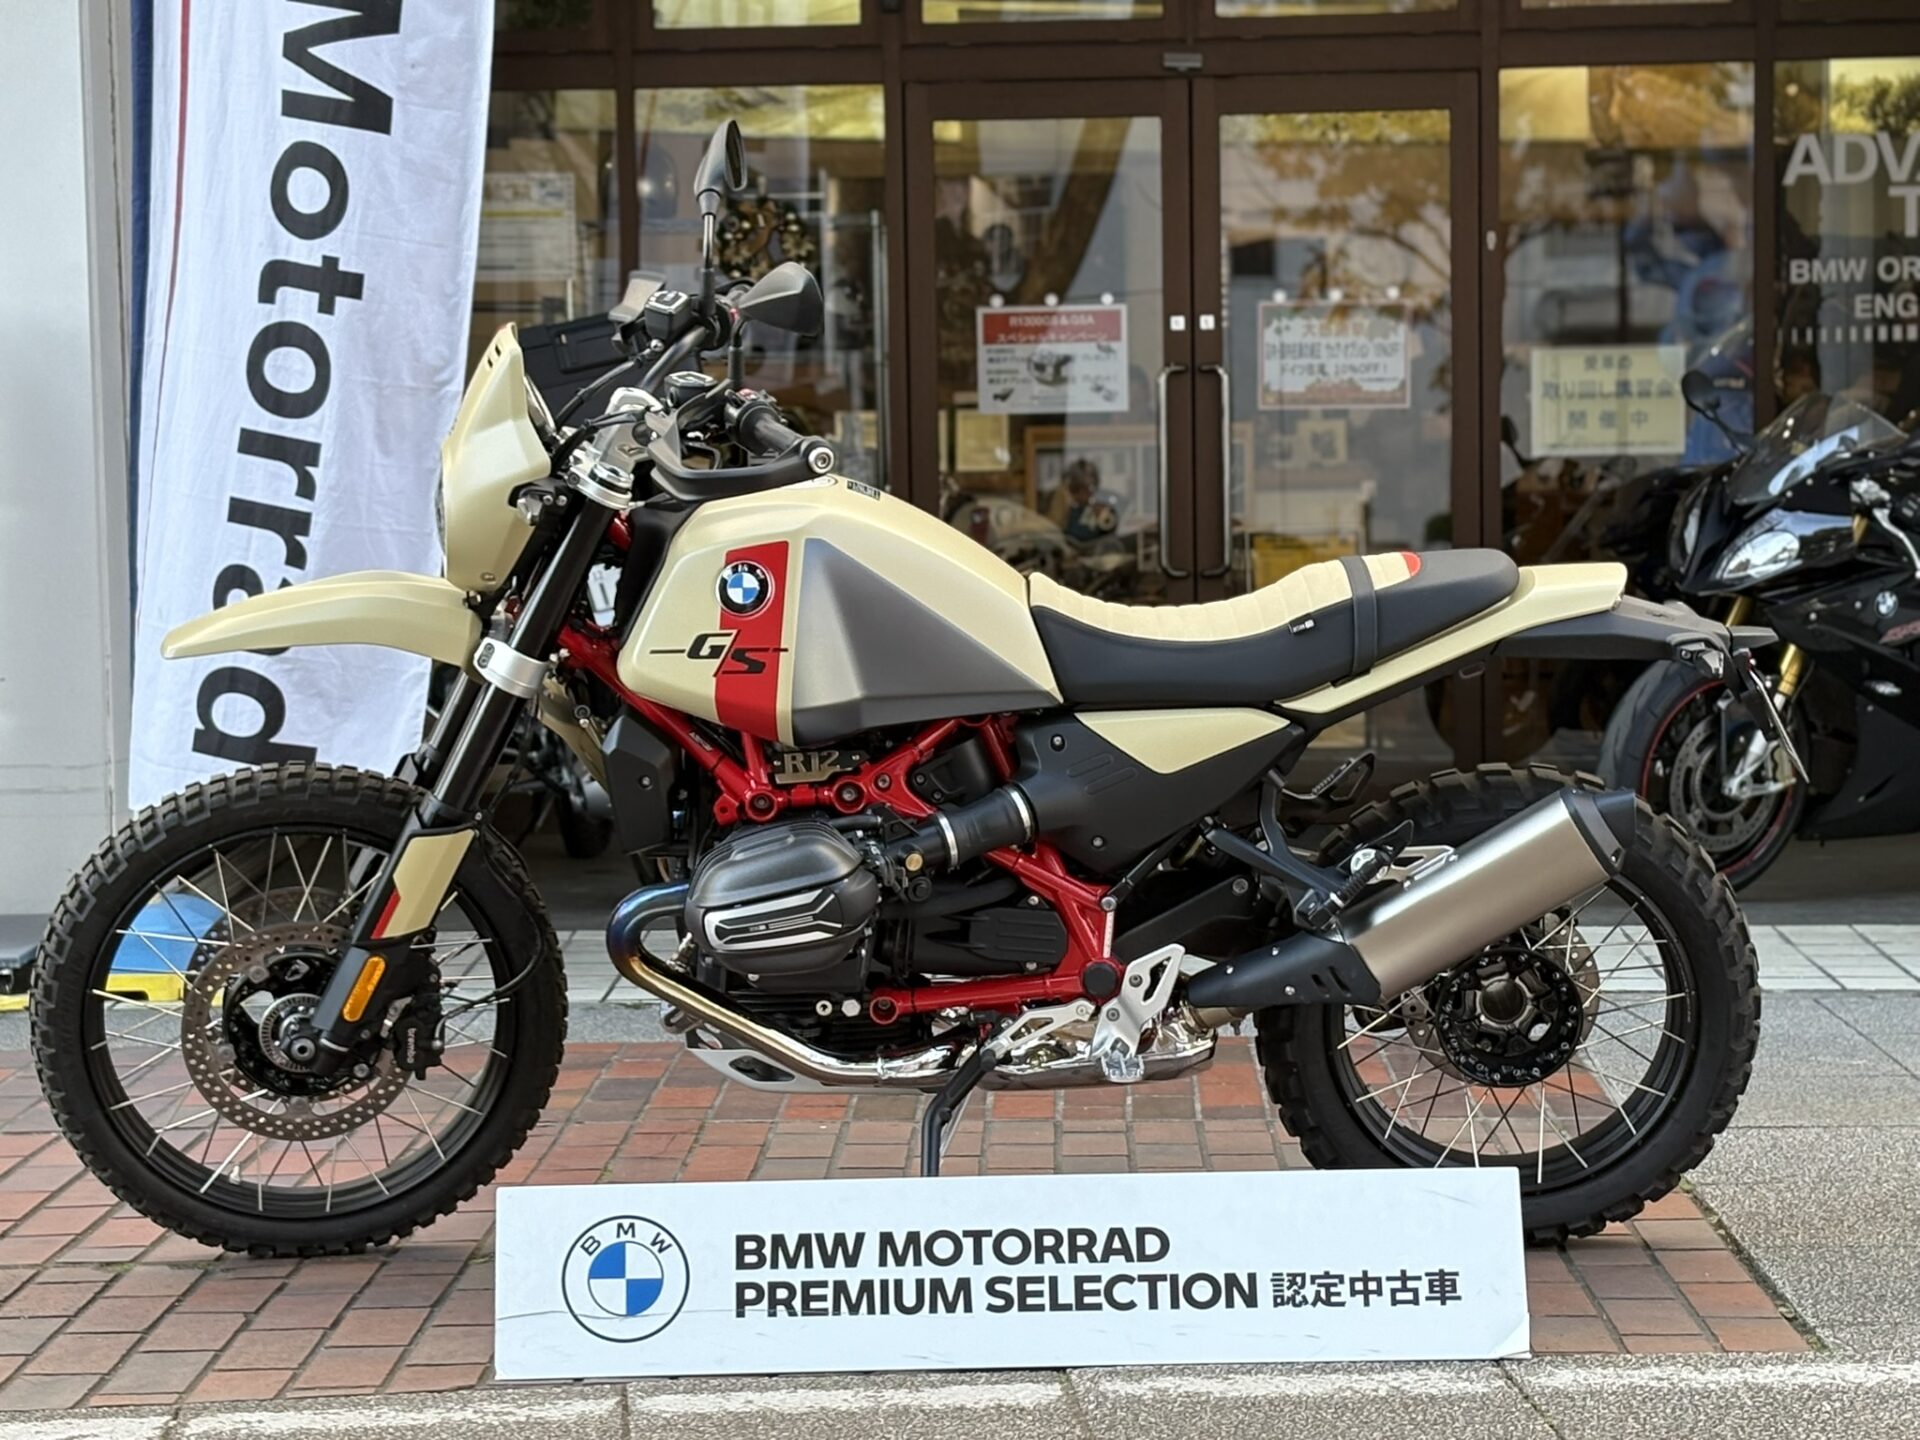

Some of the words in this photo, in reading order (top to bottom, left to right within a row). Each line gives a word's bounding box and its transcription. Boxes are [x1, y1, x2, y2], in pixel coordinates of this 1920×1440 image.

[1781, 130, 1920, 187] ADV
[1788, 257, 1868, 285] BMW
[1877, 255, 1920, 283] OR
[1853, 292, 1919, 319] ENG
[580, 1222, 672, 1256] BMW
[735, 1231, 866, 1271] BMW
[878, 1226, 1171, 1268] MOTORRAD
[735, 1277, 974, 1319] PREMIUM
[986, 1272, 1258, 1314] SELECTION
[1270, 1268, 1463, 1308] 認定中古車
